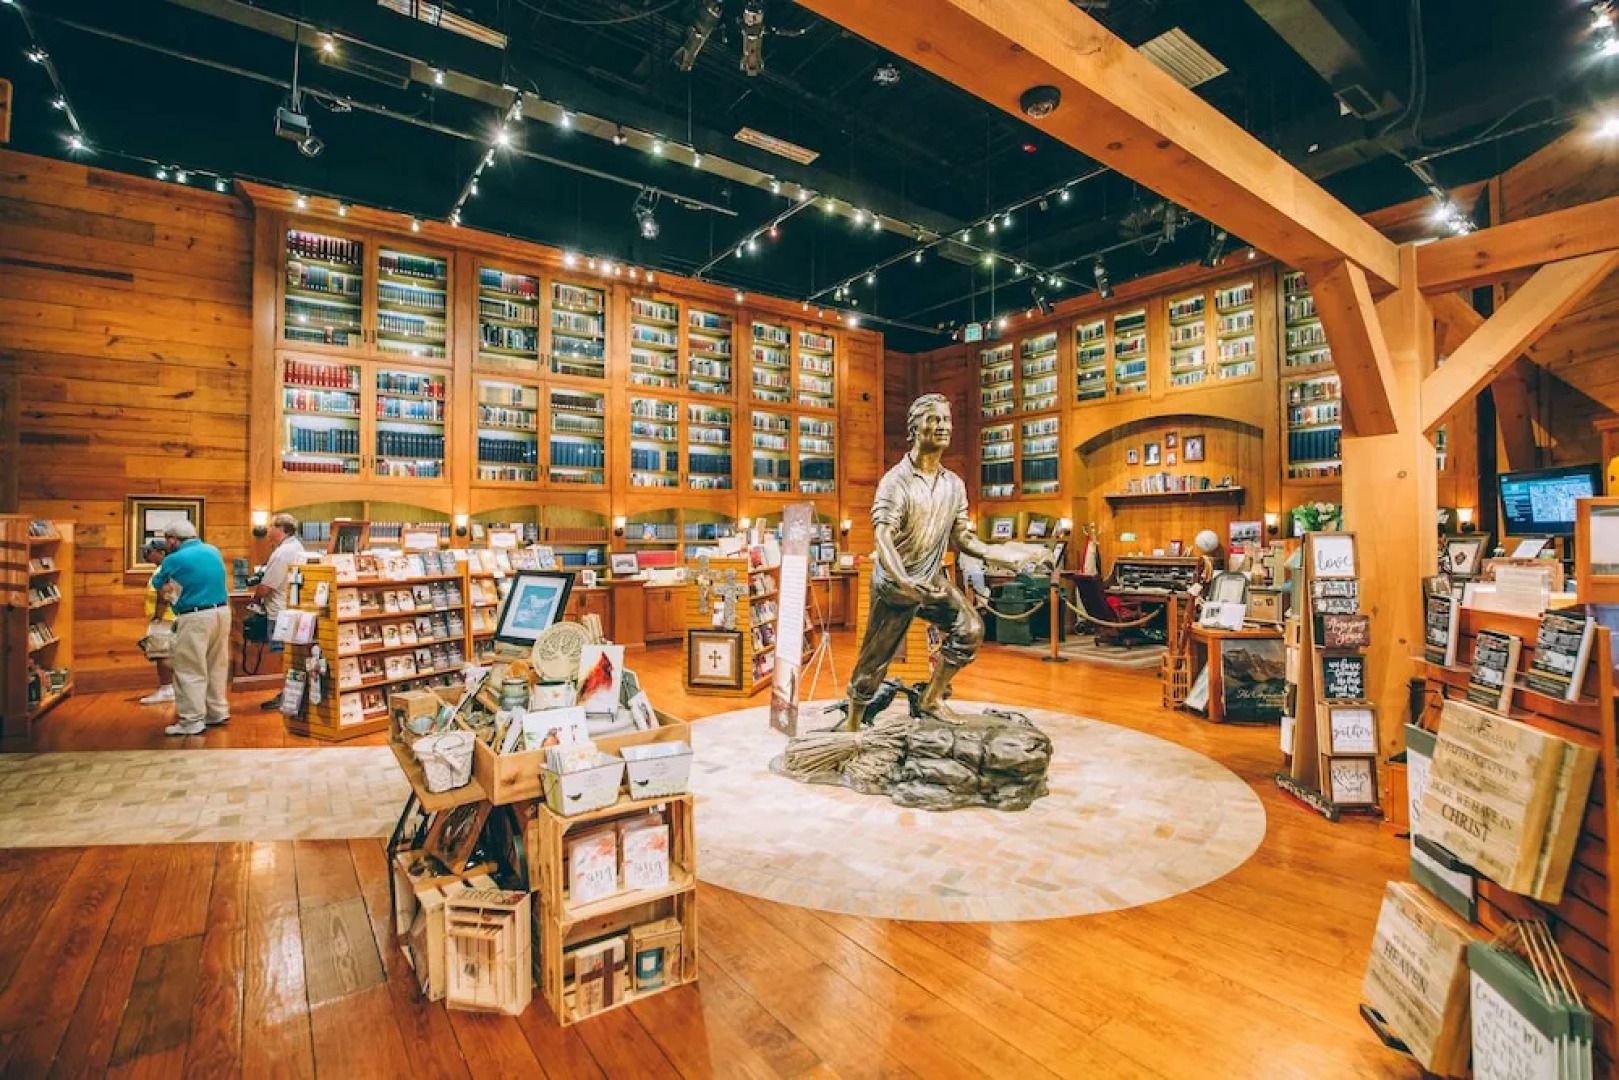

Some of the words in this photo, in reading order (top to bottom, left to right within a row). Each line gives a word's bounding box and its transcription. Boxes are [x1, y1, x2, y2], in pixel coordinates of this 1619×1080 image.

[1317, 550, 1351, 571] love
[1333, 724, 1371, 741] gather
[1441, 803, 1491, 843] CHRIST
[1384, 940, 1429, 995] HEAVEN
